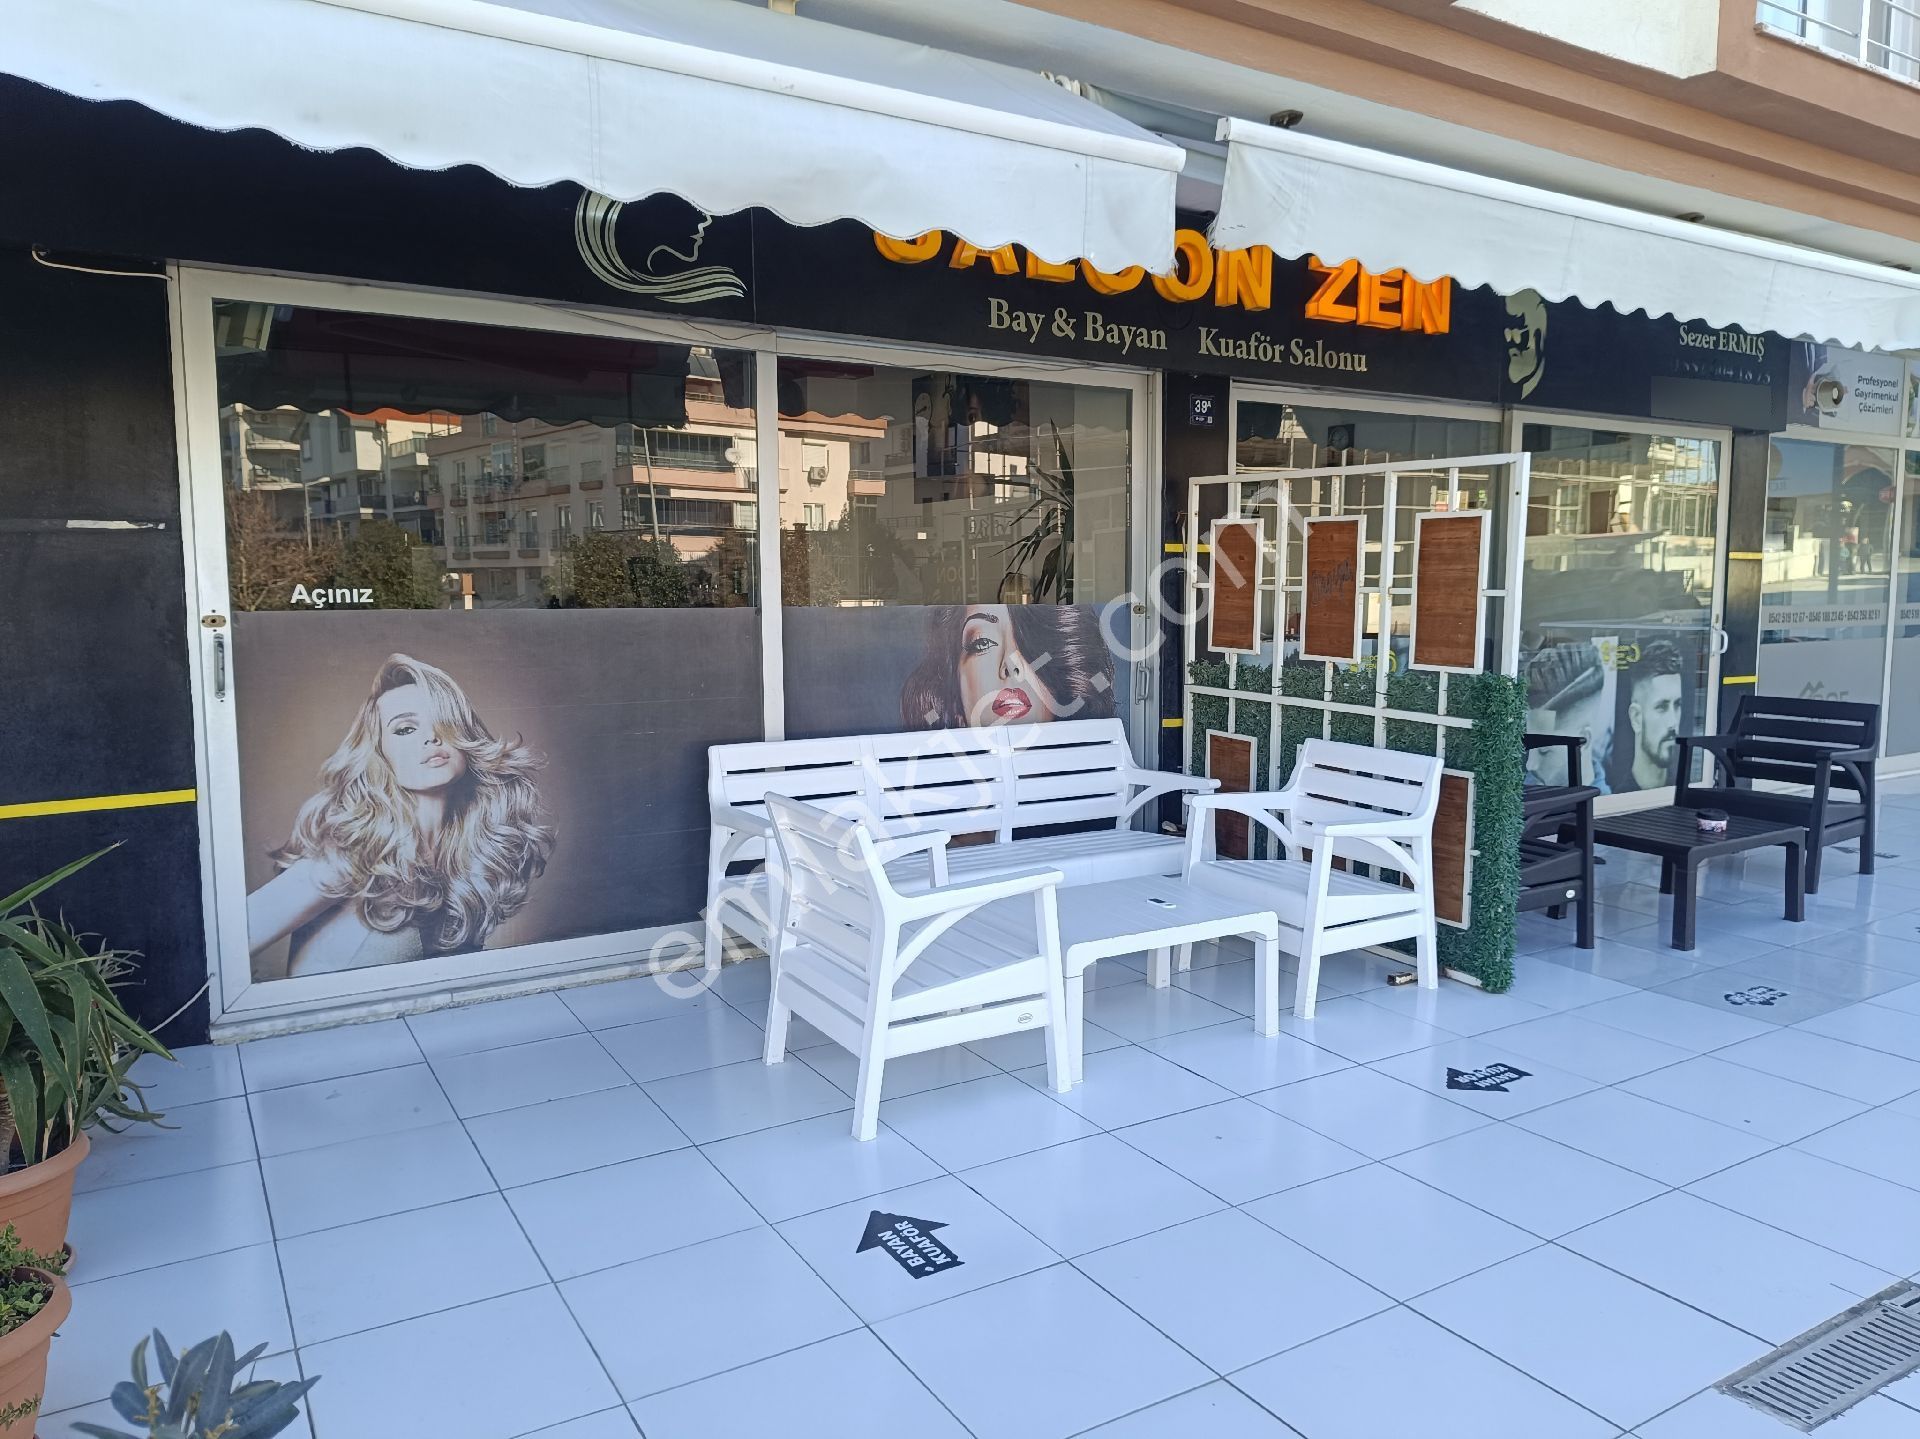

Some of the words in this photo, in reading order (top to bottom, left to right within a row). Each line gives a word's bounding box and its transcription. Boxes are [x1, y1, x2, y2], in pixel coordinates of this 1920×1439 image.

[1305, 255, 1451, 335] ZEN
[987, 297, 1046, 344] Bay
[1051, 307, 1077, 341] &
[1083, 311, 1168, 356] Bayan
[1198, 326, 1285, 363] Kuaför
[1289, 338, 1368, 372] Salonu
[1679, 324, 1717, 350] Sezer
[1854, 388, 1899, 402] Gayrimenkul
[1857, 375, 1899, 389] Profesyonel
[1858, 401, 1894, 415] Çözümleri
[290, 583, 374, 609] Açınız
[877, 1230, 926, 1267] BAYAN
[894, 1220, 952, 1265] KUAFÖR
